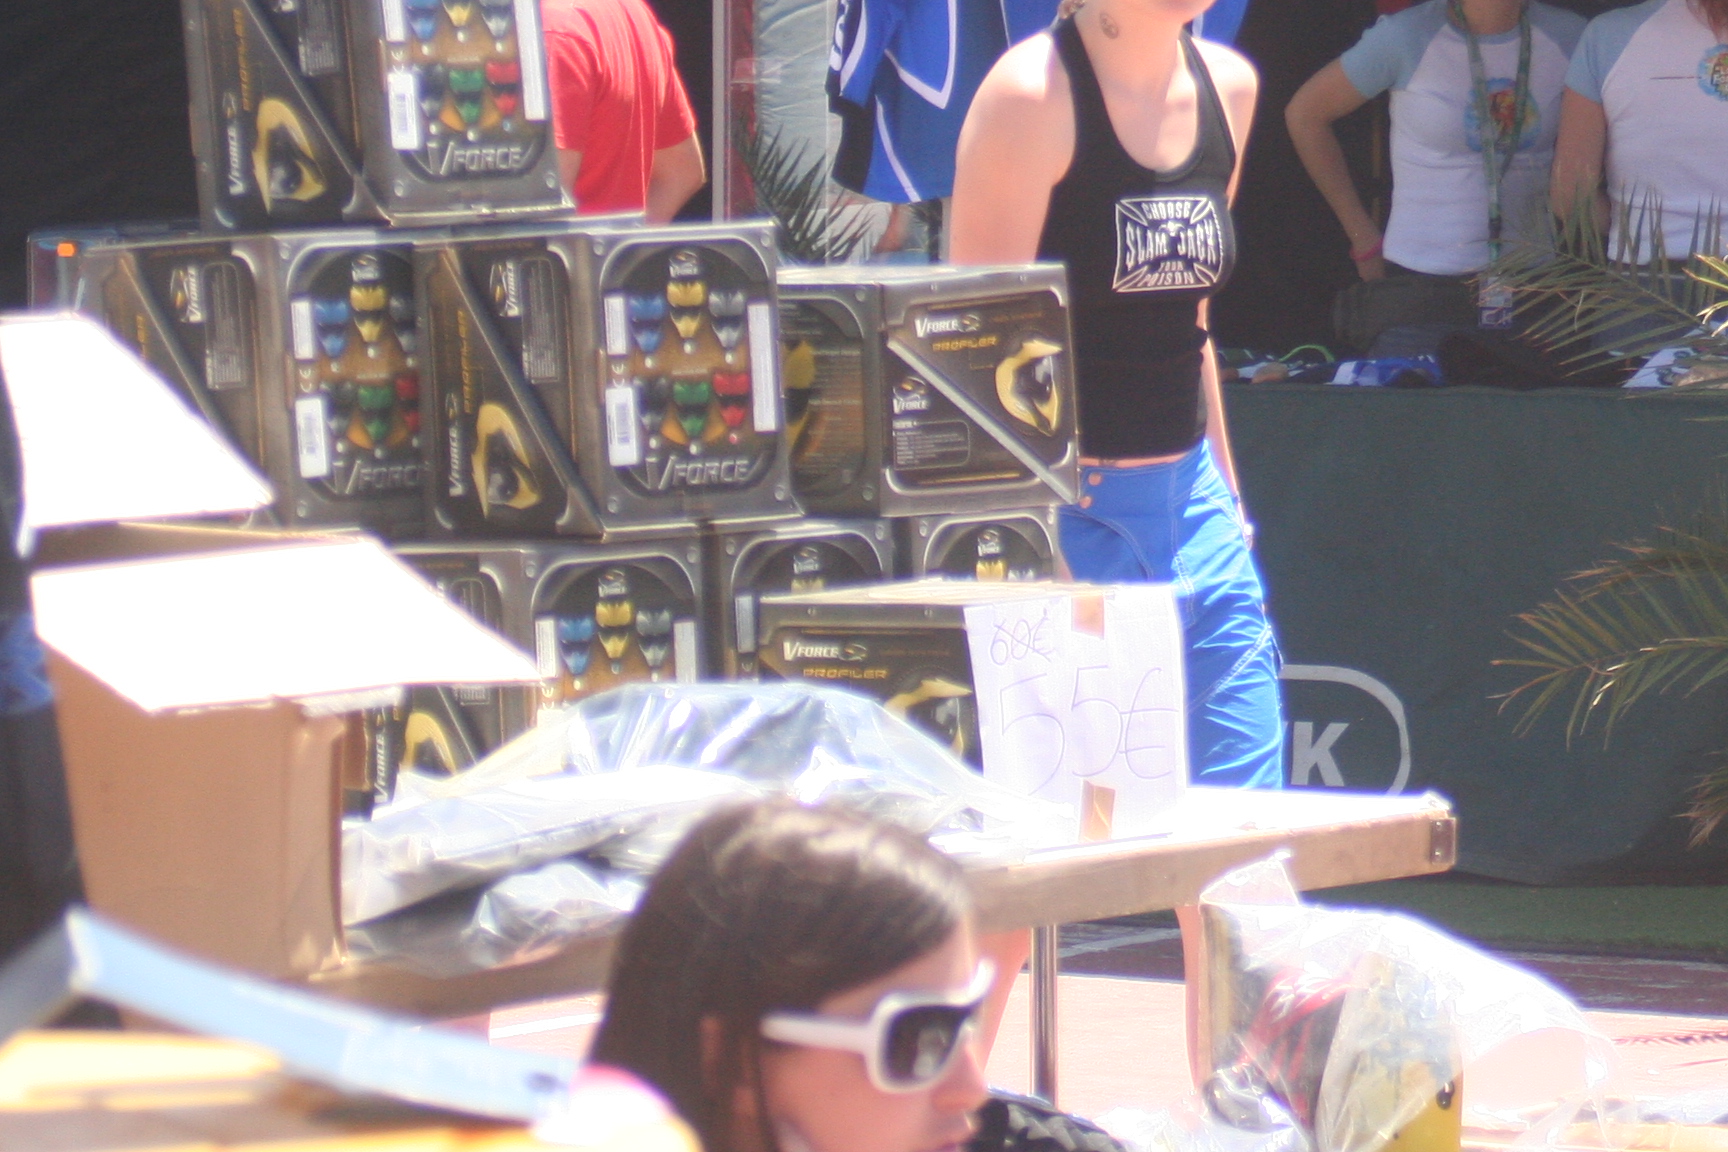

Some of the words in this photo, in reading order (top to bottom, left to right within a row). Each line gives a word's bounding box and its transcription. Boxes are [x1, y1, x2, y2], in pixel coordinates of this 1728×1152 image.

[427, 140, 523, 177] VFORCE
[1141, 200, 1191, 220] CHOOSE
[1125, 221, 1168, 272] SLAM
[1177, 218, 1216, 265] JACK
[1137, 271, 1195, 288] POISON
[914, 315, 958, 338] VFORCE
[645, 454, 751, 491] VFORCE
[782, 641, 840, 662] VFORCE
[803, 667, 889, 681] PROFILER
[1000, 664, 1180, 796] 55€
